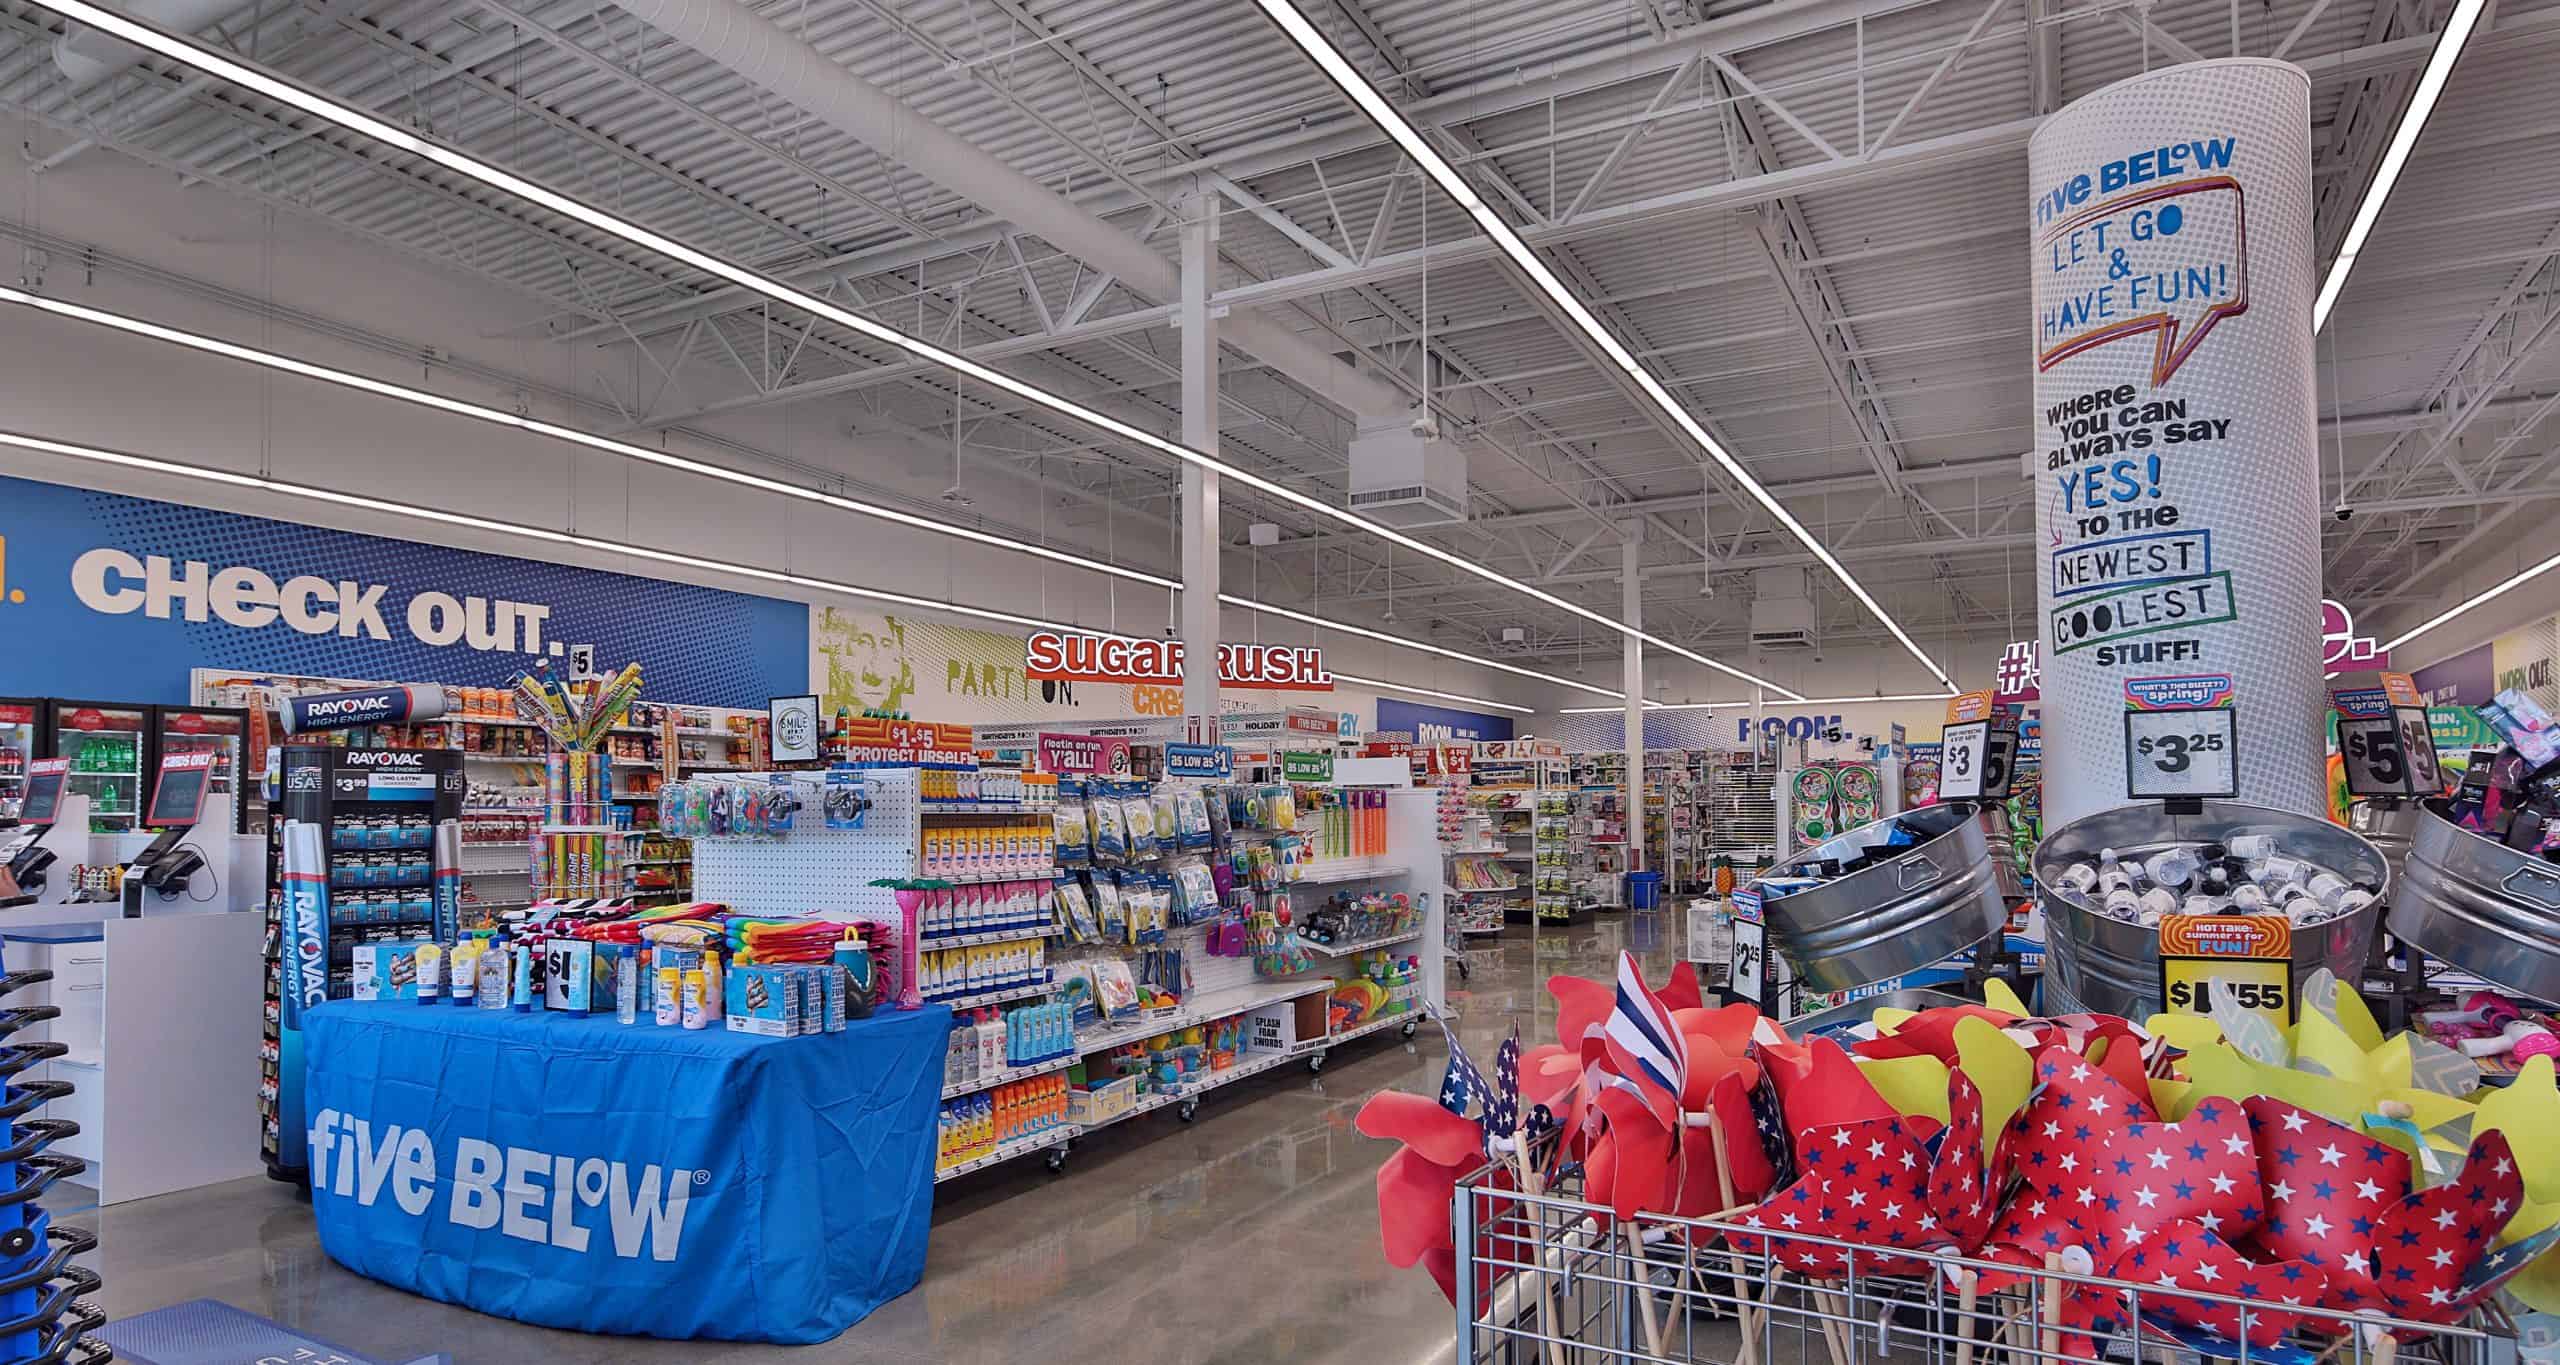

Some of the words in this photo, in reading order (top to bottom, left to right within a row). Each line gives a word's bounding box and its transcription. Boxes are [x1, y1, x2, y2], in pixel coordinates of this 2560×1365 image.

[2037, 174, 2091, 227] five
[2054, 220, 2112, 273] LET
[2130, 204, 2183, 241] GO
[2109, 247, 2131, 280] &
[2044, 285, 2114, 341] HAVE
[2131, 263, 2226, 309] FUN!
[2059, 454, 2161, 513] YES!
[2077, 515, 2109, 538] TO
[2060, 541, 2195, 586] NEWEST
[2058, 584, 2211, 643] COOLEST
[573, 651, 588, 673] $5
[1042, 680, 1079, 707] ON.
[2133, 683, 2168, 691] WHAT'S
[2149, 688, 2208, 701] spring!
[308, 696, 390, 716] RAYOVAC
[2350, 700, 2388, 712] spring!
[307, 716, 338, 727] HIGH
[339, 711, 388, 724] ENERGY
[781, 716, 808, 728] SMILE
[1821, 726, 1842, 742] $5
[347, 752, 423, 765] RAYOVAC
[1949, 746, 1970, 776] $3
[2350, 730, 2402, 784] $5
[2401, 721, 2434, 780] $5
[1171, 754, 1182, 766] as
[1184, 755, 1200, 767] LOW
[1203, 757, 1213, 768] as
[1215, 751, 1227, 773] $1
[1451, 757, 1467, 771] $1
[287, 776, 316, 789] USA
[443, 780, 462, 790] US
[2186, 932, 2242, 940] summer's
[2245, 932, 2264, 941] for
[2196, 924, 2218, 932] HOT
[295, 891, 327, 1007] RAYOVAC
[2200, 941, 2251, 954] FUN!
[286, 936, 300, 1004] ENERGY
[1255, 1017, 1280, 1028] SPLASH
[1259, 1027, 1277, 1037] FOAM
[1254, 1037, 1283, 1048] SWORDS
[308, 1108, 435, 1215] five
